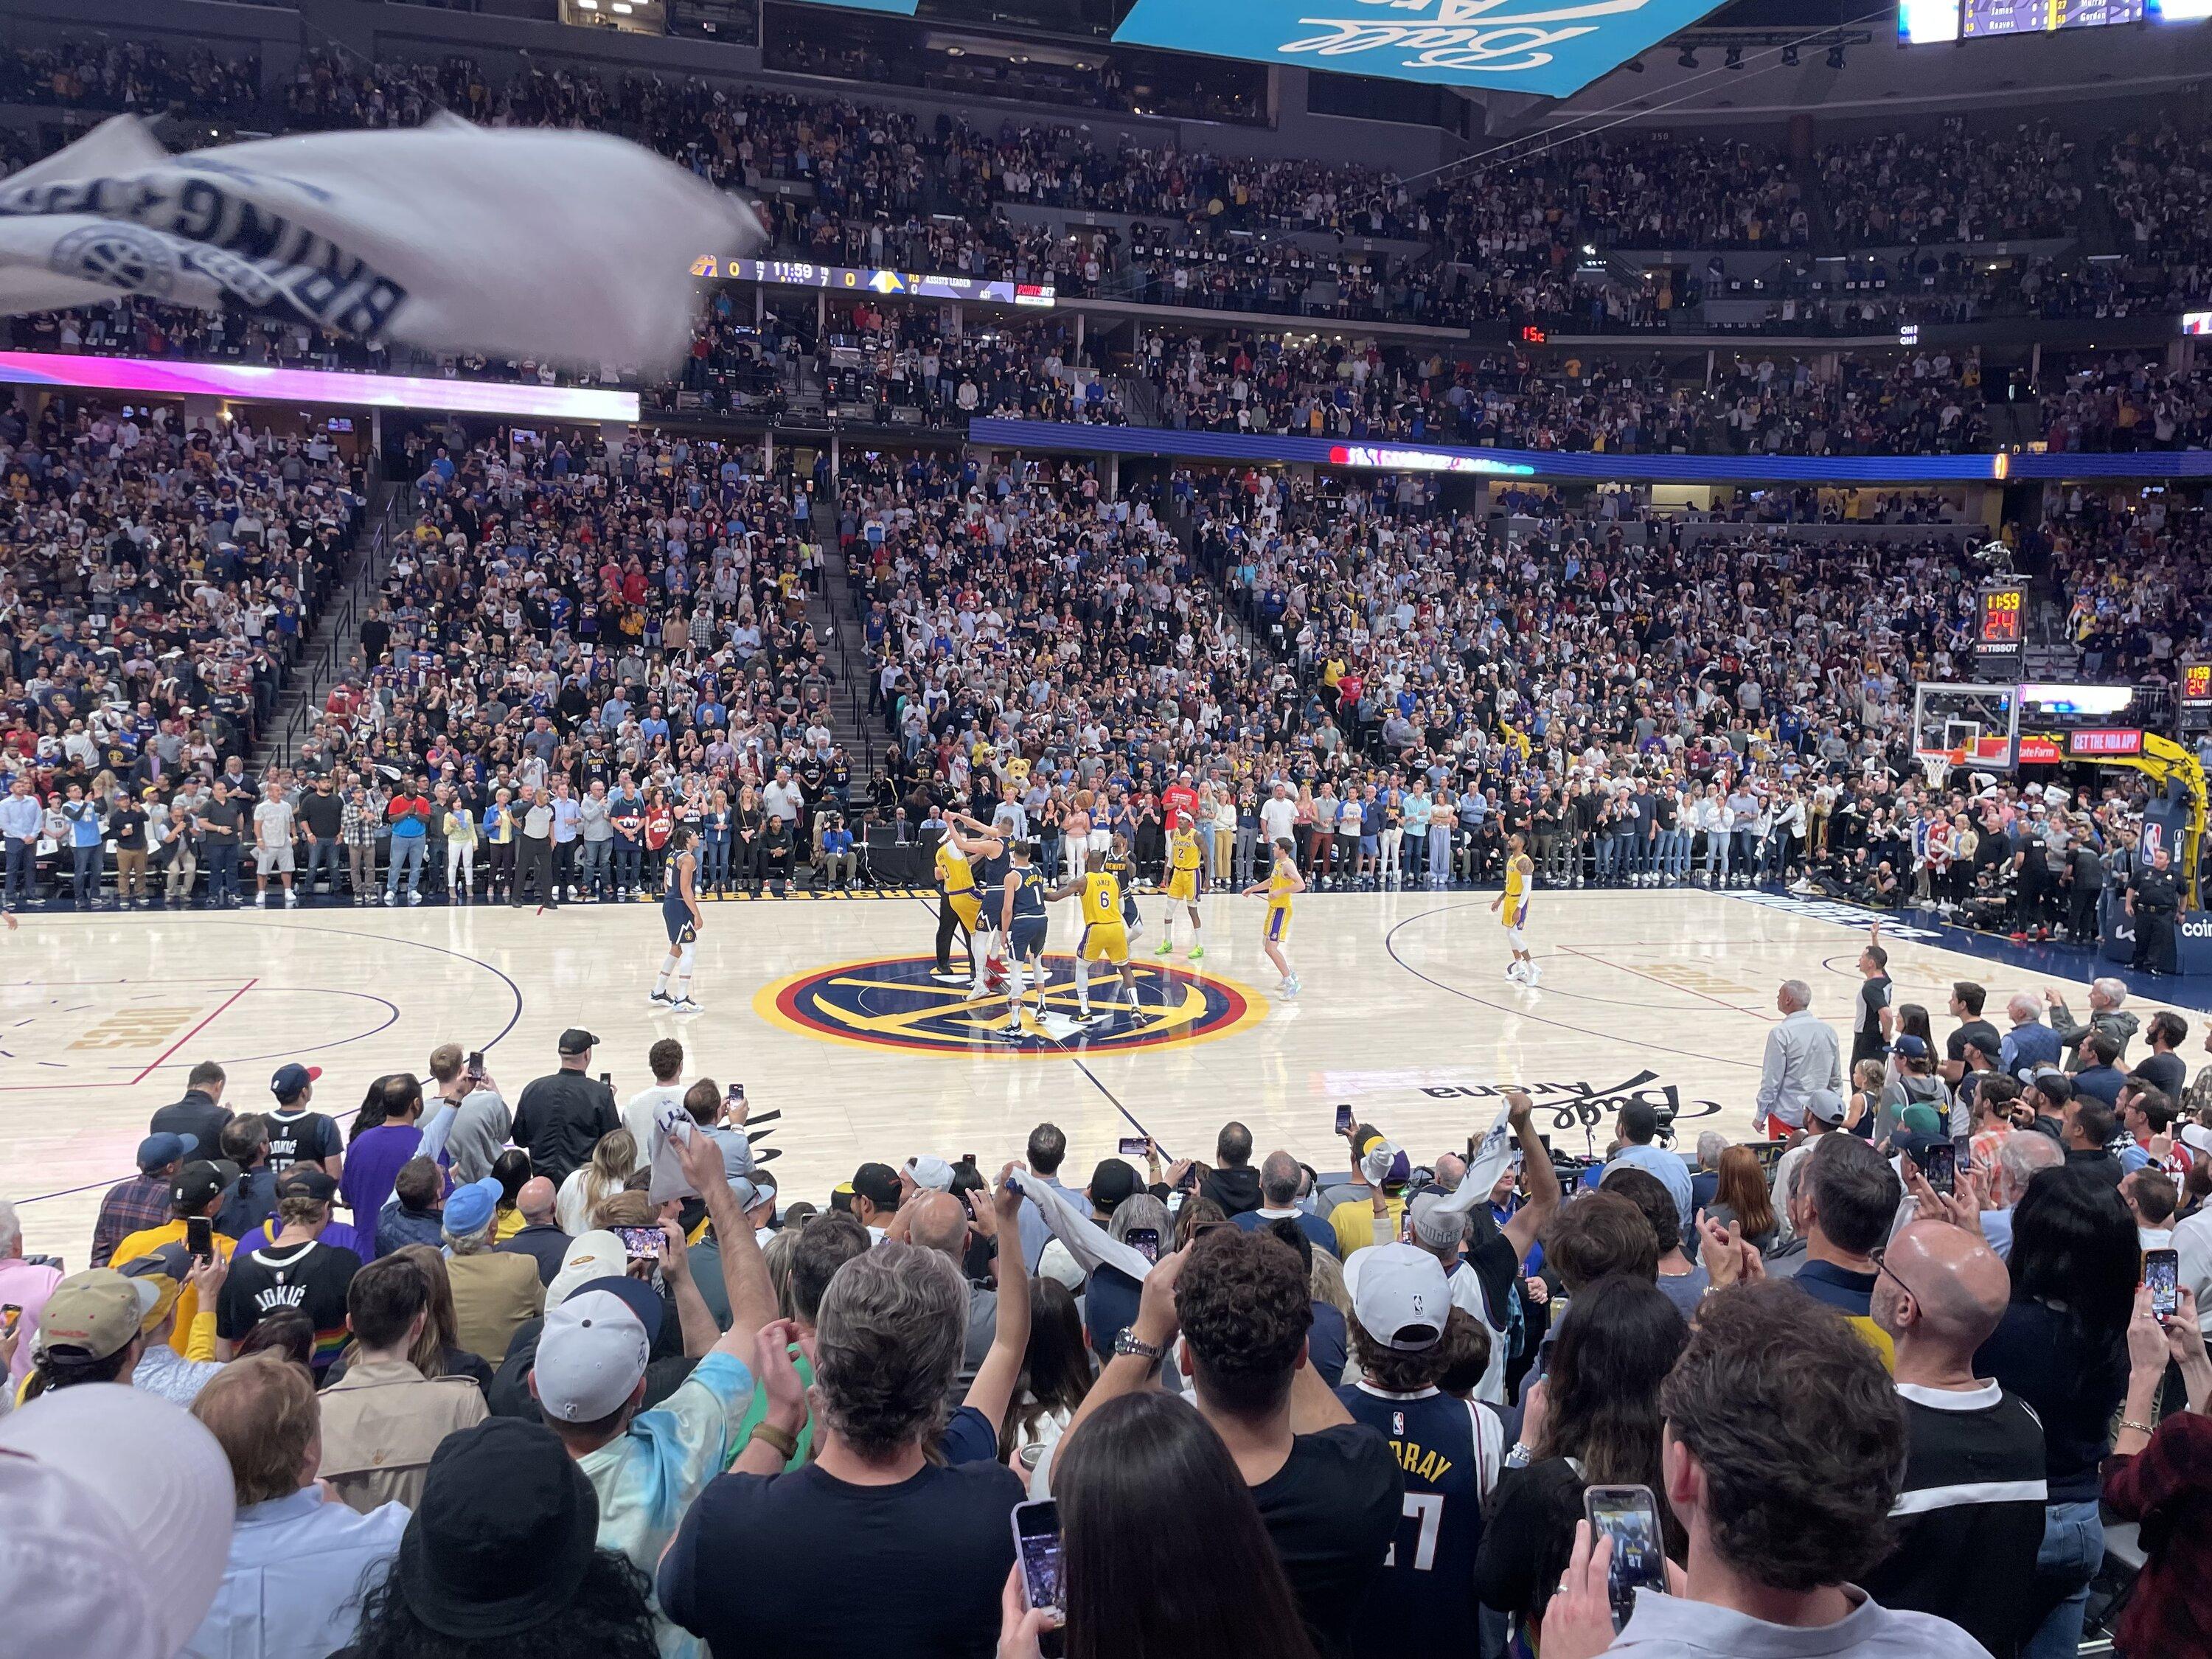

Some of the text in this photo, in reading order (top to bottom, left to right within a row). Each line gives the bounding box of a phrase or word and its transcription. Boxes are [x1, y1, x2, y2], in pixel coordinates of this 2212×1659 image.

[1991, 6, 2014, 15] James
[2080, 11, 2107, 21] Gordon
[1989, 21, 2014, 30] Reaves
[1278, 20, 1600, 70] Ball
[728, 262, 740, 276] 0
[757, 271, 764, 281] 7
[774, 262, 813, 278] 11:59
[821, 276, 828, 286] 7
[845, 272, 855, 287] 0
[908, 274, 919, 283] FLS
[925, 275, 971, 287] ASSISTS LEADER
[1988, 593, 2020, 611] 11:59
[1985, 611, 2015, 639] 24
[2188, 666, 2211, 680] 11:59
[2188, 680, 2206, 696] 24
[2074, 734, 2136, 749] GET THE NBA APP
[591, 765, 602, 773] 50
[838, 773, 846, 782] 27
[1178, 849, 1184, 859] 2
[627, 889, 939, 902] BASKETBAL
[1033, 885, 1042, 905] 1
[1100, 890, 1110, 908] 6
[64, 1006, 204, 1050] 5280
[1419, 1082, 1596, 1102] Arena
[269, 1139, 297, 1155] JOKIĆ
[254, 1285, 307, 1312] JOKIĆ
[1385, 1492, 1446, 1571] 7
